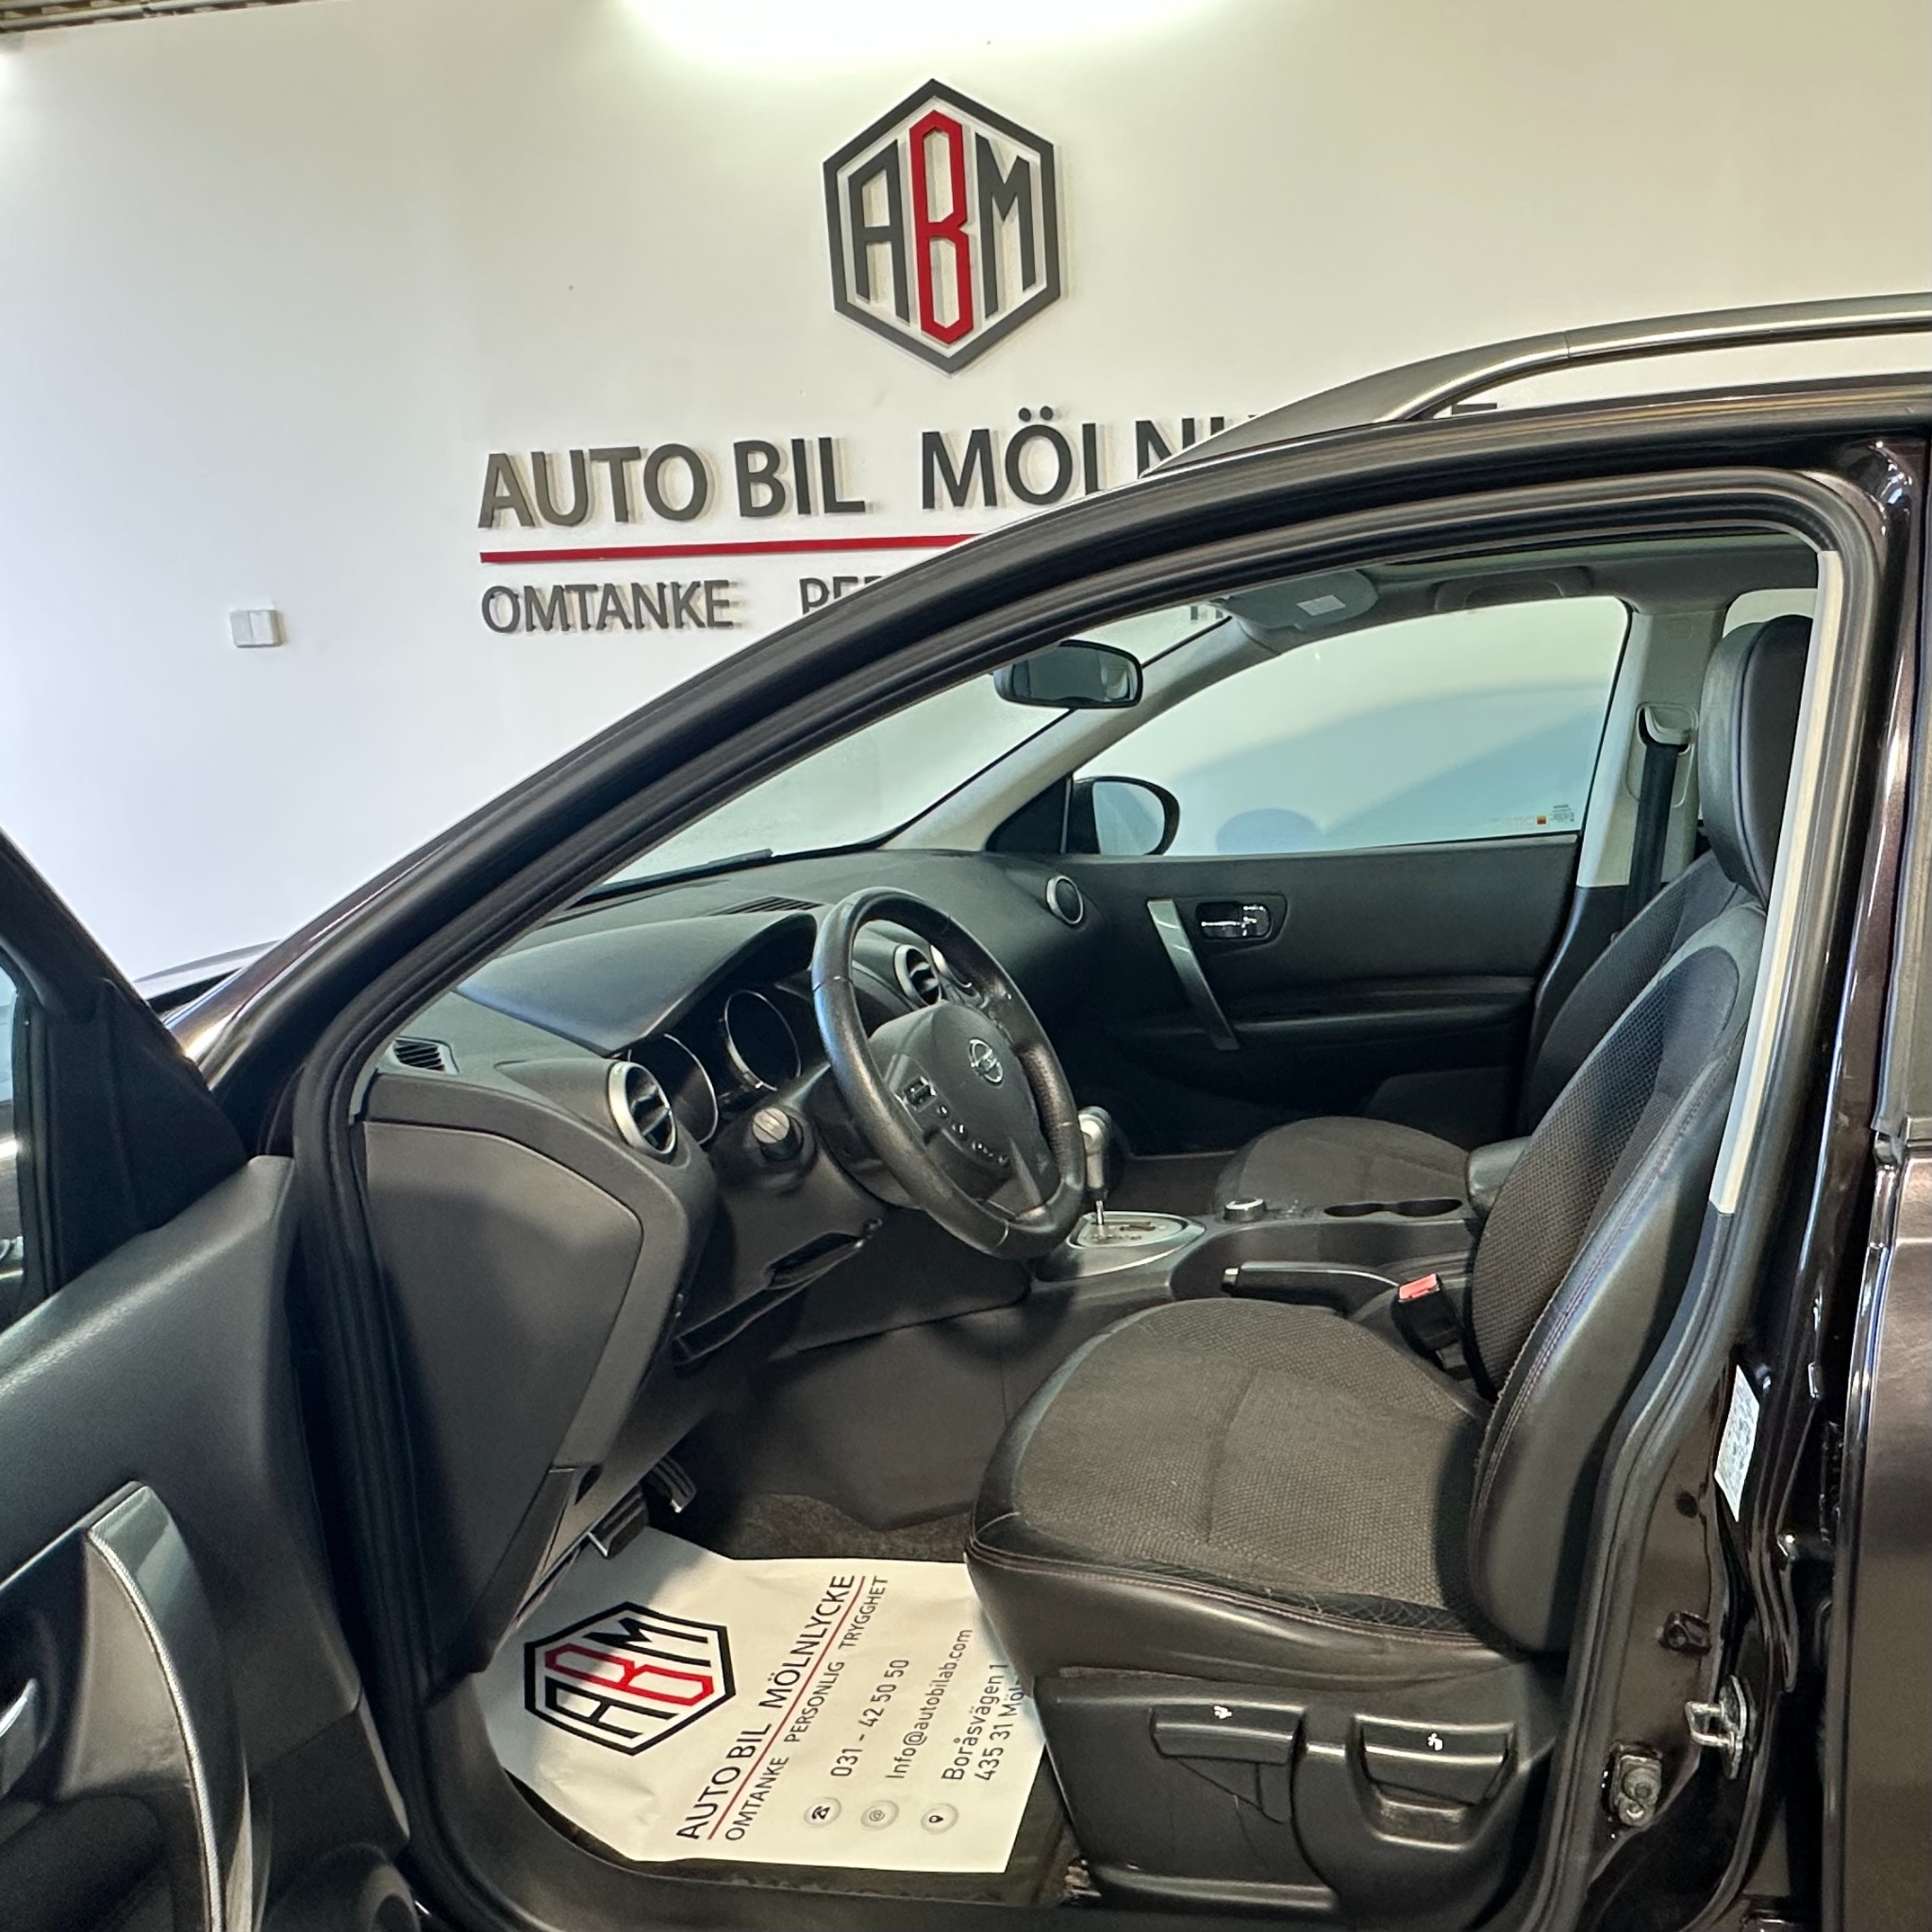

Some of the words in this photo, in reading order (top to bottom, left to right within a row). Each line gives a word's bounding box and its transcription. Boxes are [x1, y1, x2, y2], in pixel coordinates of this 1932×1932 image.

[848, 108, 1037, 345] ABM
[478, 442, 709, 528] AUTO
[734, 436, 866, 518] BIL
[922, 405, 1257, 509] MÖLN
[481, 579, 735, 634] OMTANKE
[544, 1617, 715, 1740] ABM
[871, 1684, 897, 1703] 50
[884, 1659, 909, 1678] 50
[676, 1766, 741, 1840] AUTO
[726, 1723, 773, 1759] BIL
[758, 1575, 855, 1708] MÖLNLYCKE
[724, 1757, 790, 1840] OMTANKE
[784, 1660, 844, 1742] PERSONLIG
[839, 1575, 888, 1650] TRYGGHET
[858, 1707, 885, 1727] 42
[885, 1629, 974, 1779] Info@autobilab.com
[997, 1679, 1024, 1717] Möl
[941, 1674, 1005, 1780] Boråsvägen
[989, 1723, 1014, 1740] 31
[830, 1748, 863, 1776] 031
[974, 1747, 1005, 1781] 435
